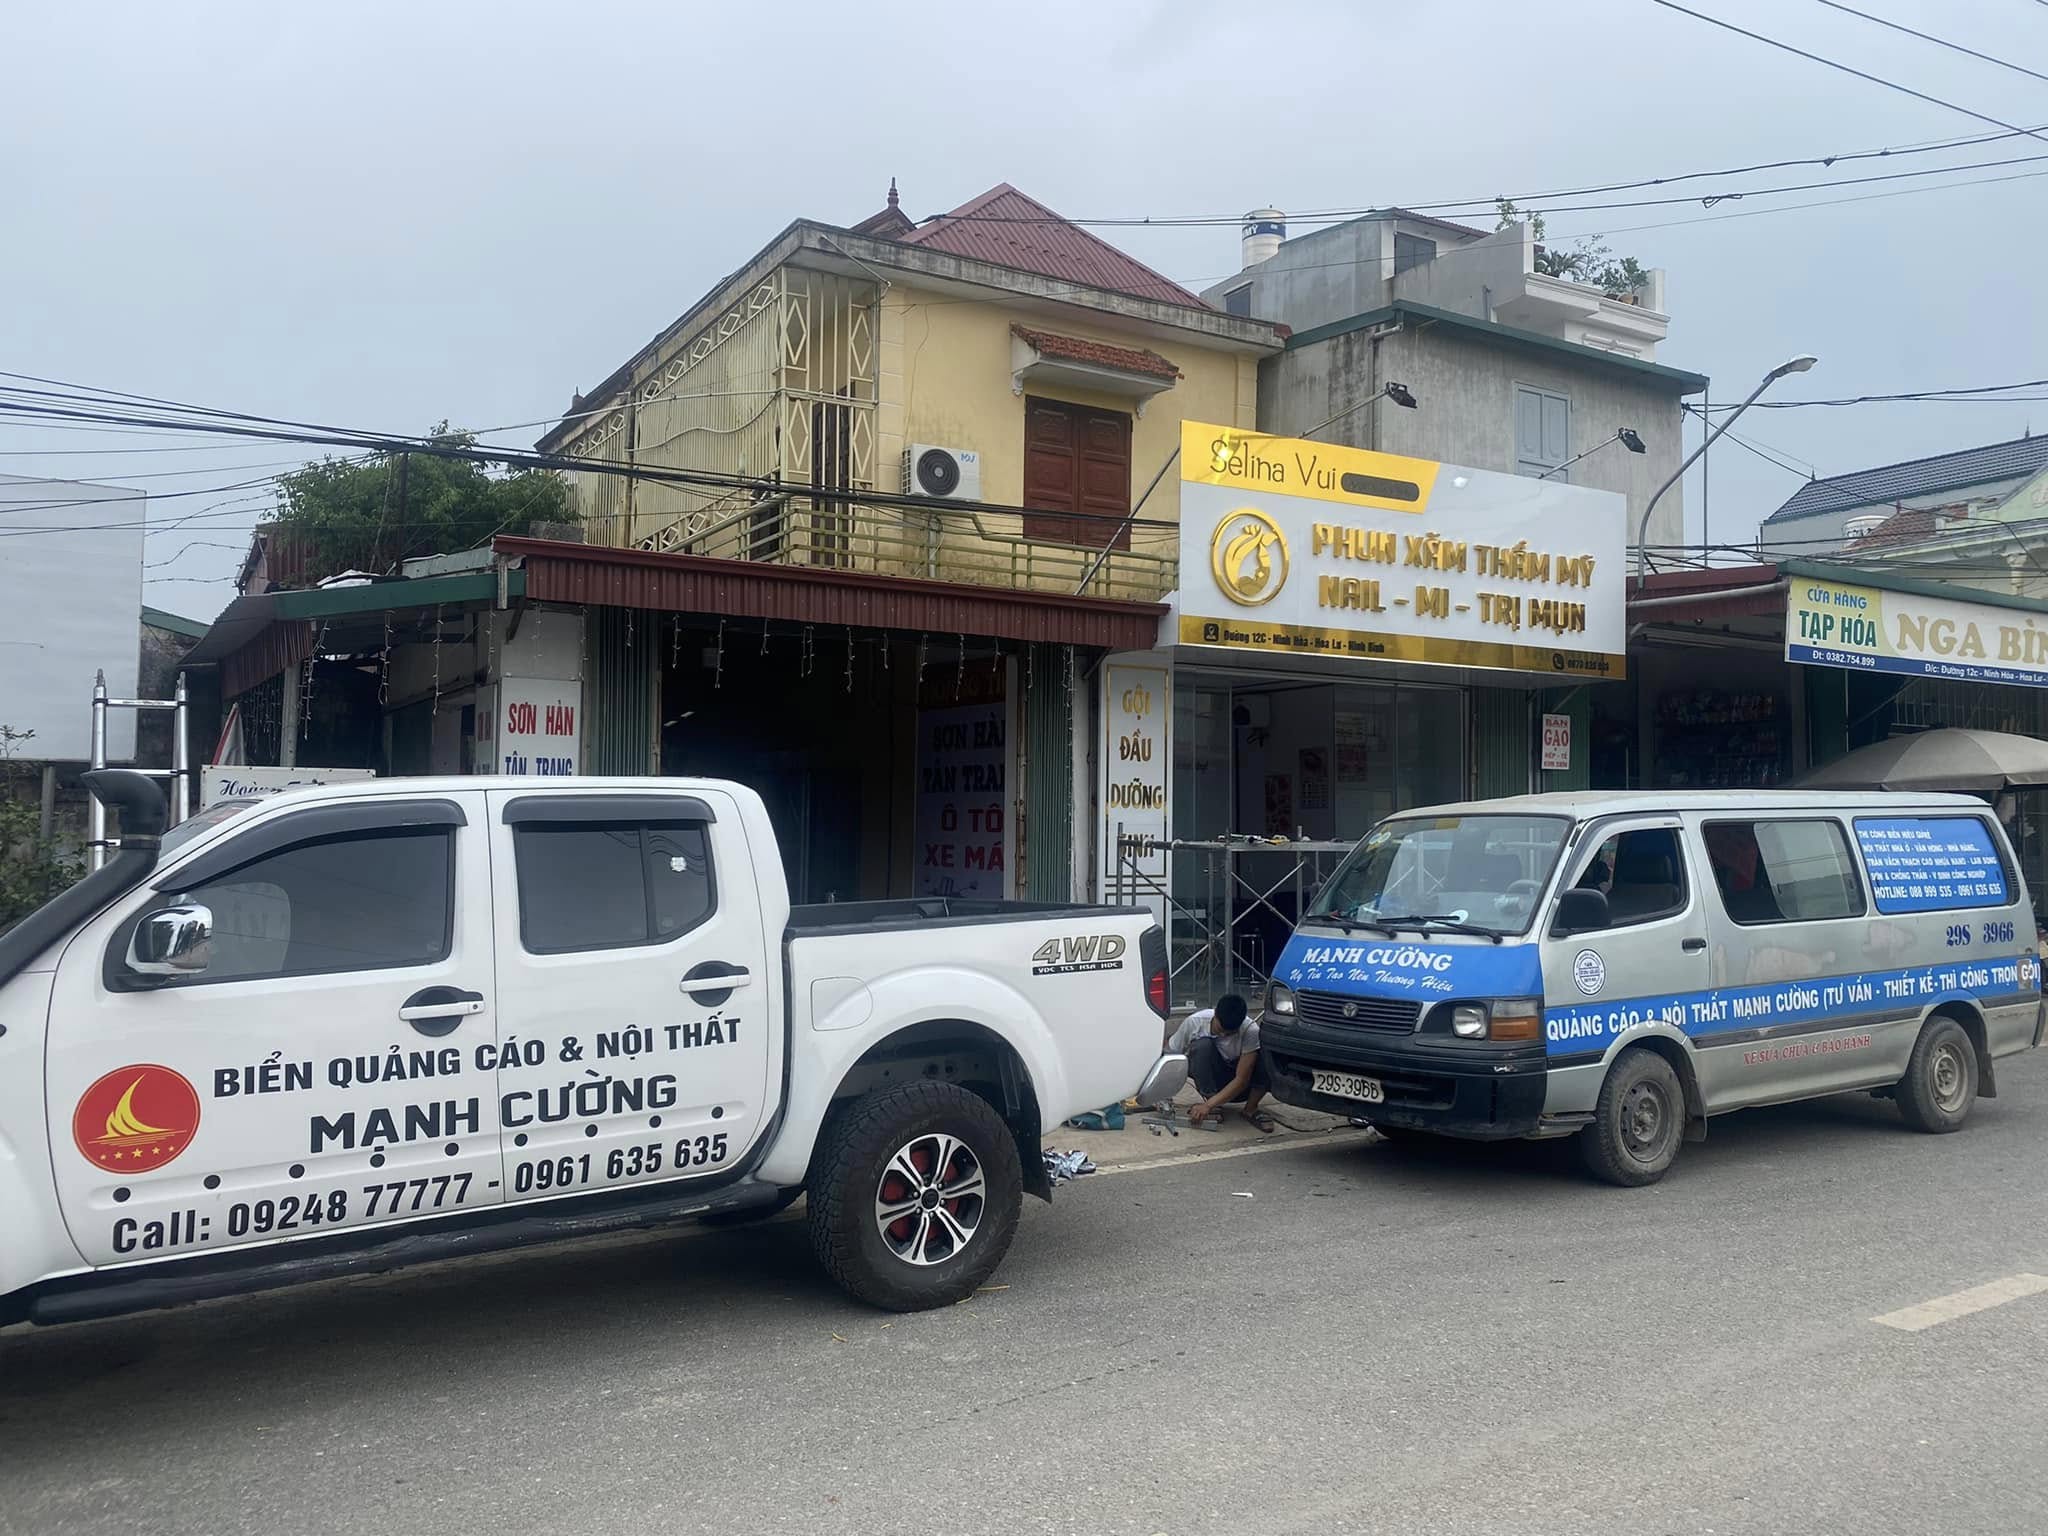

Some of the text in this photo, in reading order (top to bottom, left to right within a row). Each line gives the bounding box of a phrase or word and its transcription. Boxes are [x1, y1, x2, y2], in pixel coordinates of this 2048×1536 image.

[1296, 453, 1336, 490] Vui
[1312, 523, 1397, 565] PHUN
[1403, 531, 1467, 572] XĂM
[1556, 554, 1595, 588] MỸ
[1319, 575, 1386, 612] NAIL
[1416, 585, 1449, 619] MI
[1477, 593, 1520, 632] TRỊ
[1528, 598, 1585, 636] MỤN
[1807, 585, 1867, 609] CỬA HÀNG
[1799, 610, 1876, 648] TẠP HÓA
[1897, 614, 1986, 657] NGA
[508, 702, 537, 735] SƠN
[545, 699, 574, 736] HÀN
[1122, 684, 1152, 720] GỘI
[1120, 729, 1152, 762] ĐẦU
[1111, 778, 1163, 809] DƯỠNG
[1874, 885, 1908, 898] HOTLINE:
[1925, 885, 1937, 896] 999
[1032, 934, 1126, 963] 4WD
[1946, 921, 2014, 947] 29S 3966
[1302, 946, 1453, 971] MẠNH CƯỜNG
[1348, 968, 1369, 982] Nên
[1421, 975, 1455, 993] Hiệu
[1546, 1009, 1603, 1042] QUẢNG
[1608, 1006, 1639, 1033] CÁO
[1692, 991, 1728, 1023] THẤT
[1733, 998, 1771, 1021] MẠNH
[1776, 984, 1818, 1013] CƯỜNG
[1823, 982, 1844, 1011] (TƯ
[1847, 975, 1873, 1003] VẤN
[1883, 970, 1916, 998] THIẾT
[1919, 967, 1933, 994] KẾ
[1960, 966, 1988, 988] CÔNG
[1991, 965, 2017, 986] TRỌN
[214, 1011, 741, 1098] BIỂN QUẢNG CÁO & NỘI THẤT
[1317, 1074, 1379, 1100] 29S-3966
[310, 1069, 677, 1154] MẠNH CƯỜNG
[112, 1209, 210, 1253] Call:
[228, 1190, 347, 1238] 09248
[363, 1172, 473, 1217] 77777
[515, 1154, 590, 1193] 0961
[607, 1143, 662, 1179] 635
[674, 1132, 728, 1169] 635
